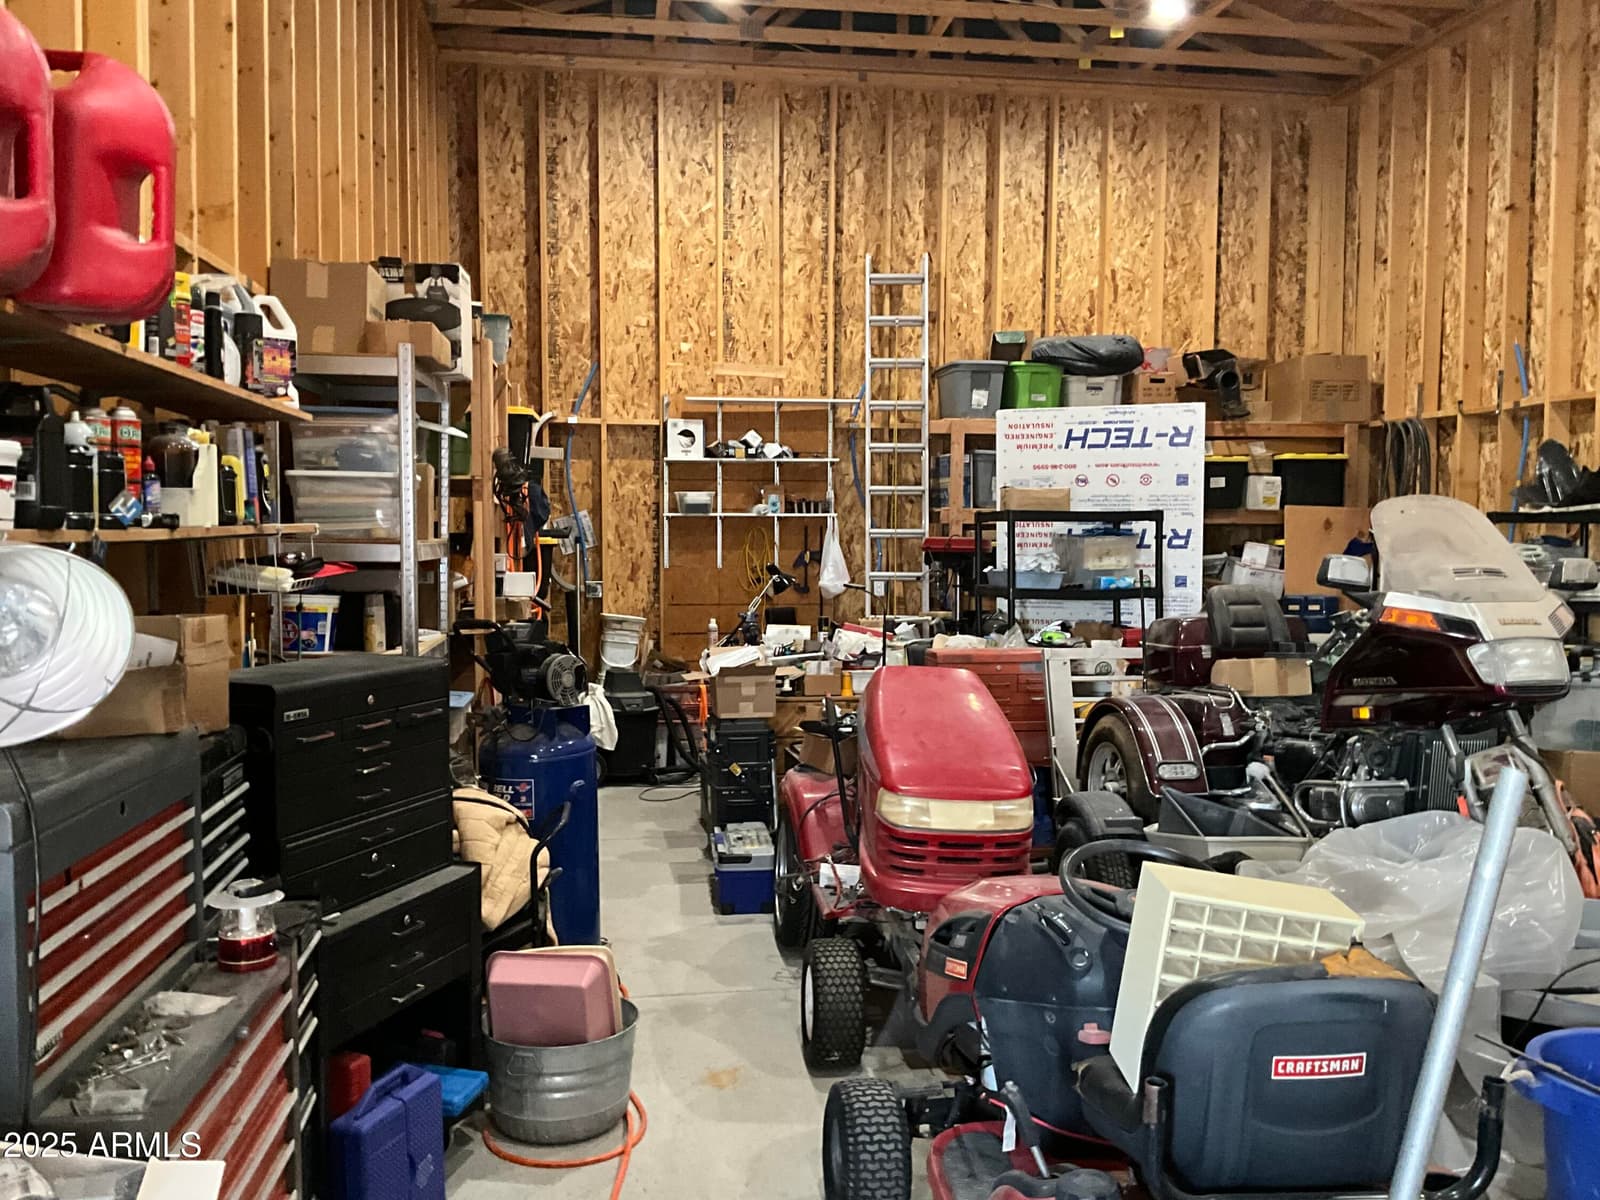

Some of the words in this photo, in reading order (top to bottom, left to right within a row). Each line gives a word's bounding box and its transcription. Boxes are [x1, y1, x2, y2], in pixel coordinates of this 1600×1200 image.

[1008, 422, 1054, 430] INSULATION
[1004, 432, 1054, 440] ENGINEERED
[1064, 426, 1194, 449] R-TECH
[1277, 1058, 1360, 1073] CRAFTSMAN
